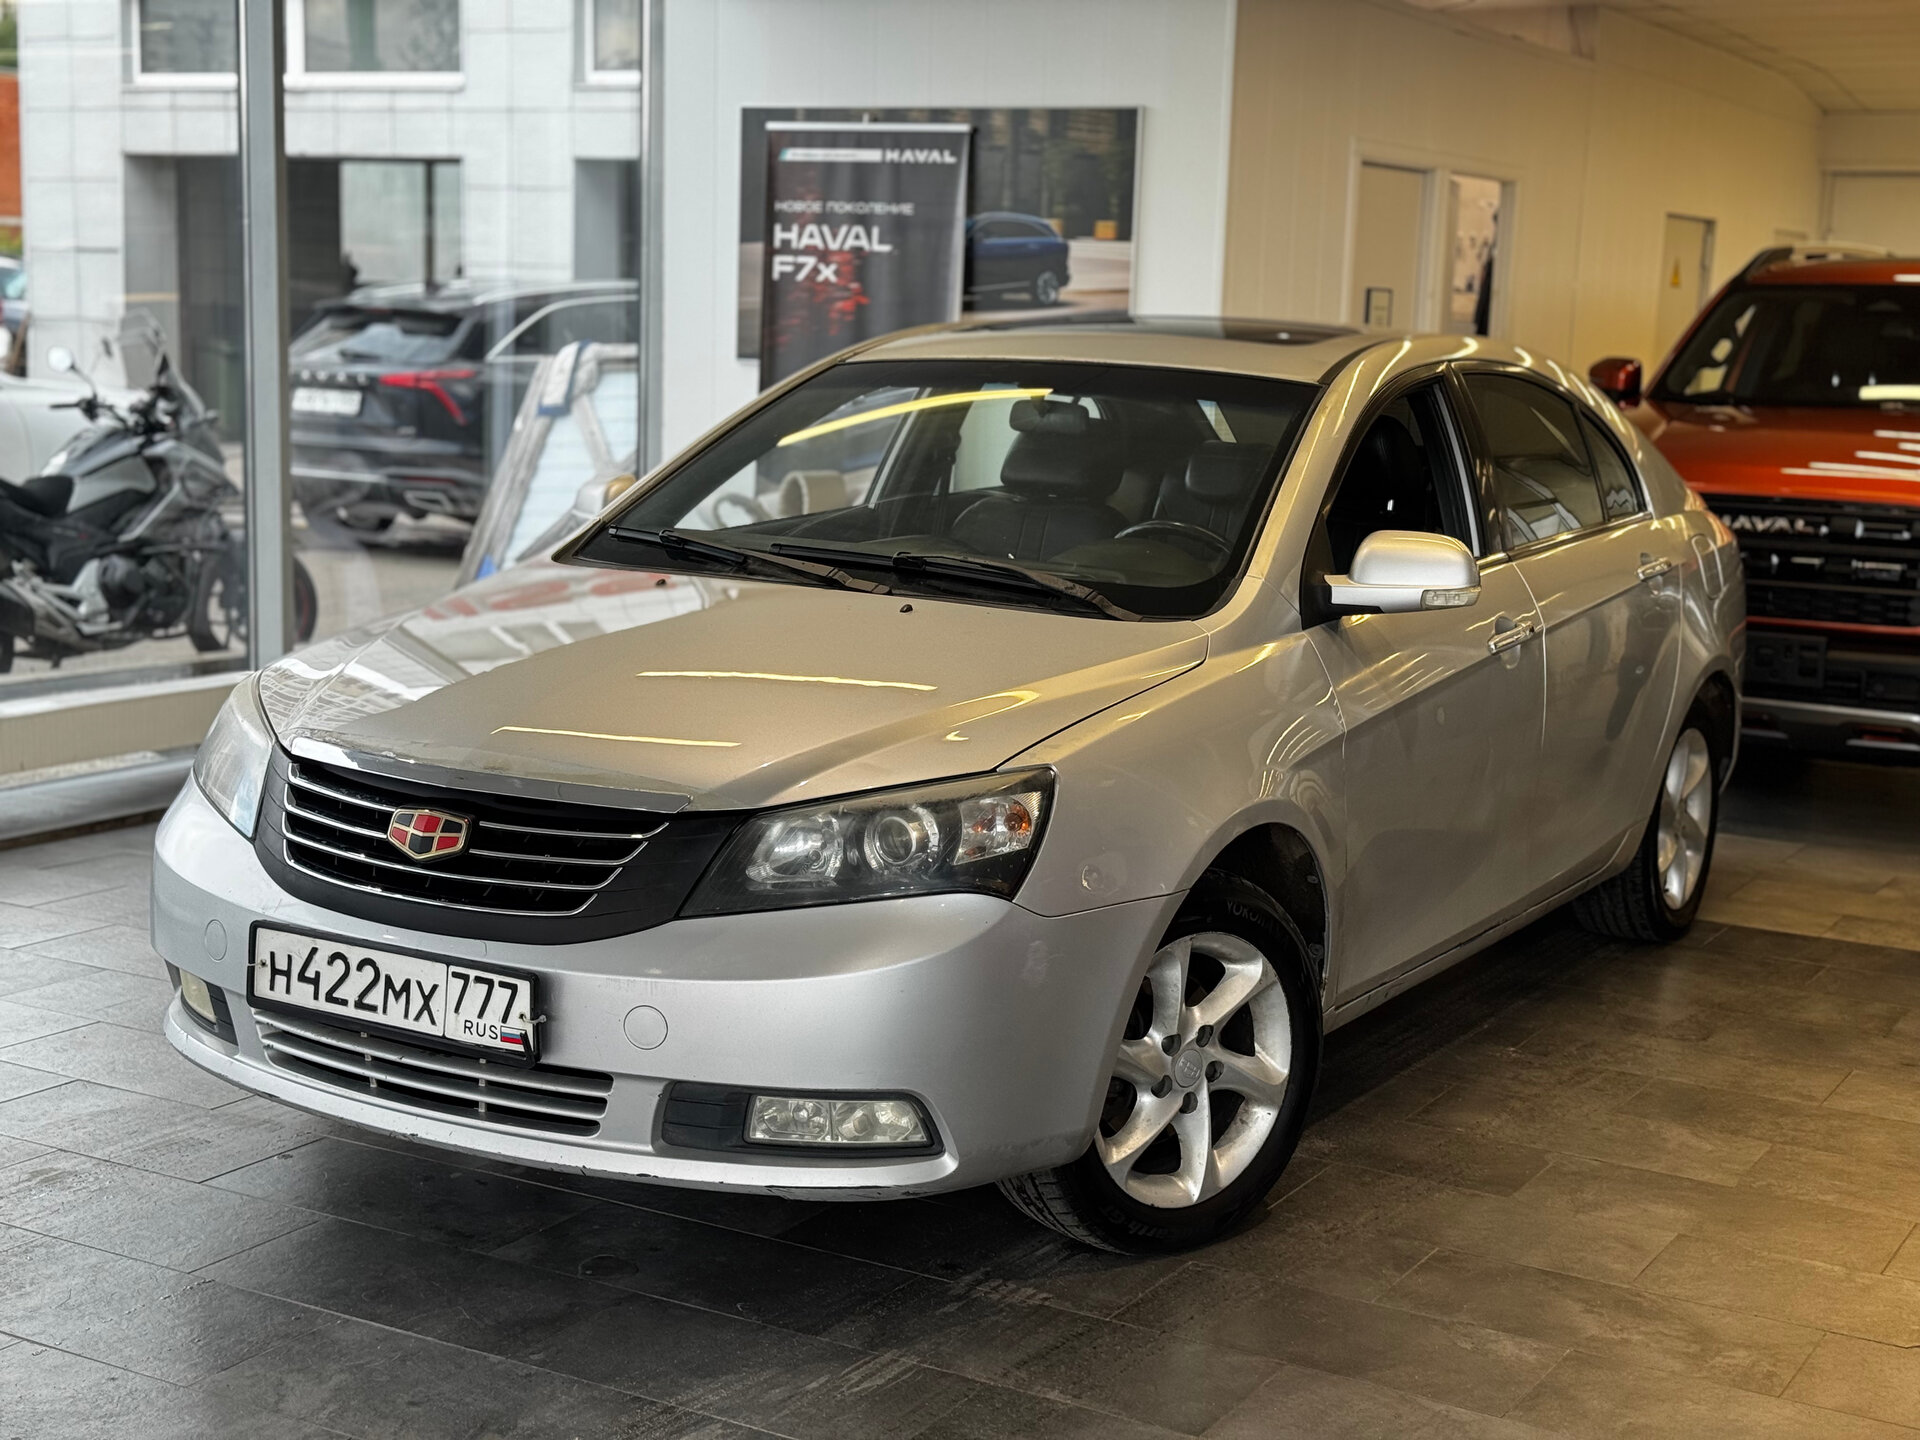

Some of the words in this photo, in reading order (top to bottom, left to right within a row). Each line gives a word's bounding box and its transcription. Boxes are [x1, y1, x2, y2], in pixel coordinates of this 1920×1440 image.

[884, 149, 957, 164] HAVAL
[773, 223, 893, 253] HAVAL
[772, 254, 839, 283] F7x
[451, 971, 519, 1025] 777
[463, 1019, 498, 1040] RUS
